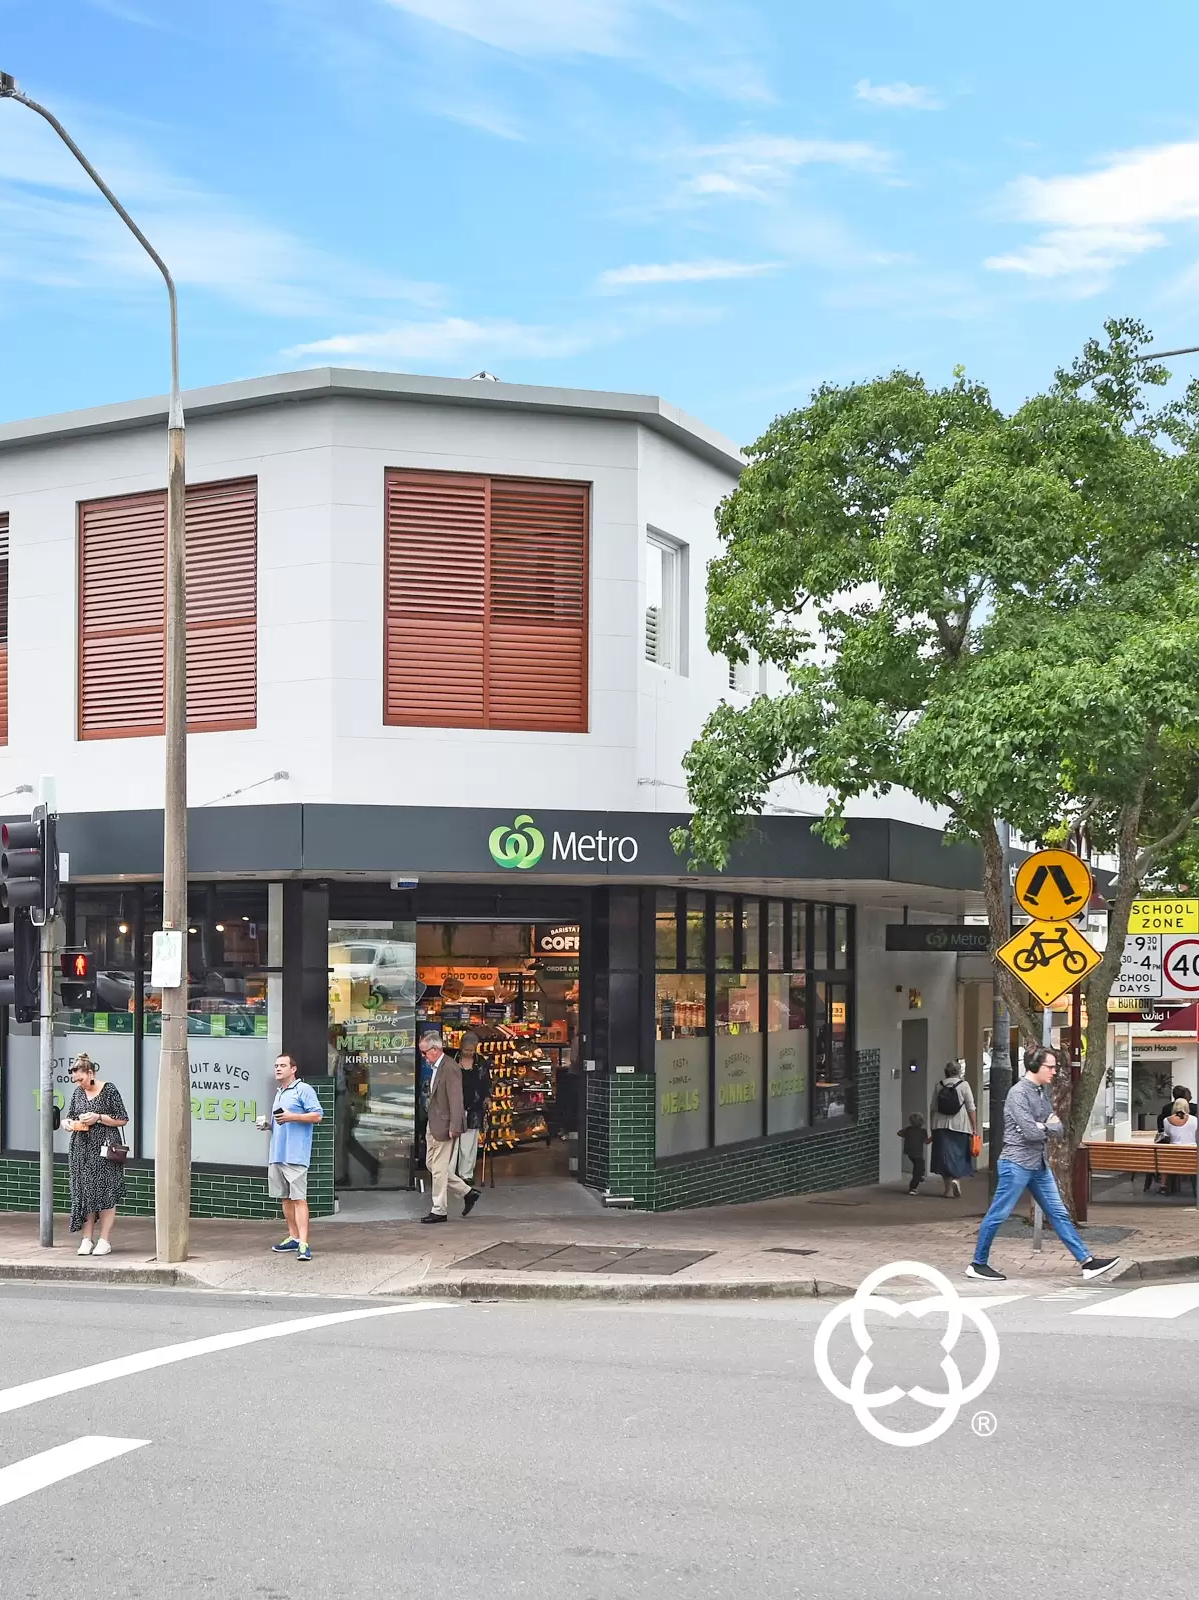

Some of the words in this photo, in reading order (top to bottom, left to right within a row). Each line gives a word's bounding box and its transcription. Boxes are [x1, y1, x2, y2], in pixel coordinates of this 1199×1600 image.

[551, 829, 638, 863] Metro
[1132, 904, 1194, 914] SCHOOL
[1142, 918, 1184, 928] ZONE
[550, 927, 576, 935] BARISTA
[951, 933, 987, 945] Metro
[1114, 974, 1156, 982] SCHOOL
[1119, 984, 1151, 993] DAYS
[344, 1013, 399, 1027] WELCOME
[1141, 1011, 1164, 1021] Wild
[336, 1035, 406, 1051] METRO
[345, 1055, 398, 1064] KIRRIBILLI
[672, 1057, 689, 1070] TASTY
[190, 1062, 209, 1074] UIT
[213, 1062, 221, 1073] &
[225, 1064, 250, 1081] VEG
[191, 1081, 231, 1091] ALWAYS
[718, 1080, 756, 1108] DINNER
[660, 1088, 701, 1116] MEALS
[190, 1096, 257, 1123] RESH
